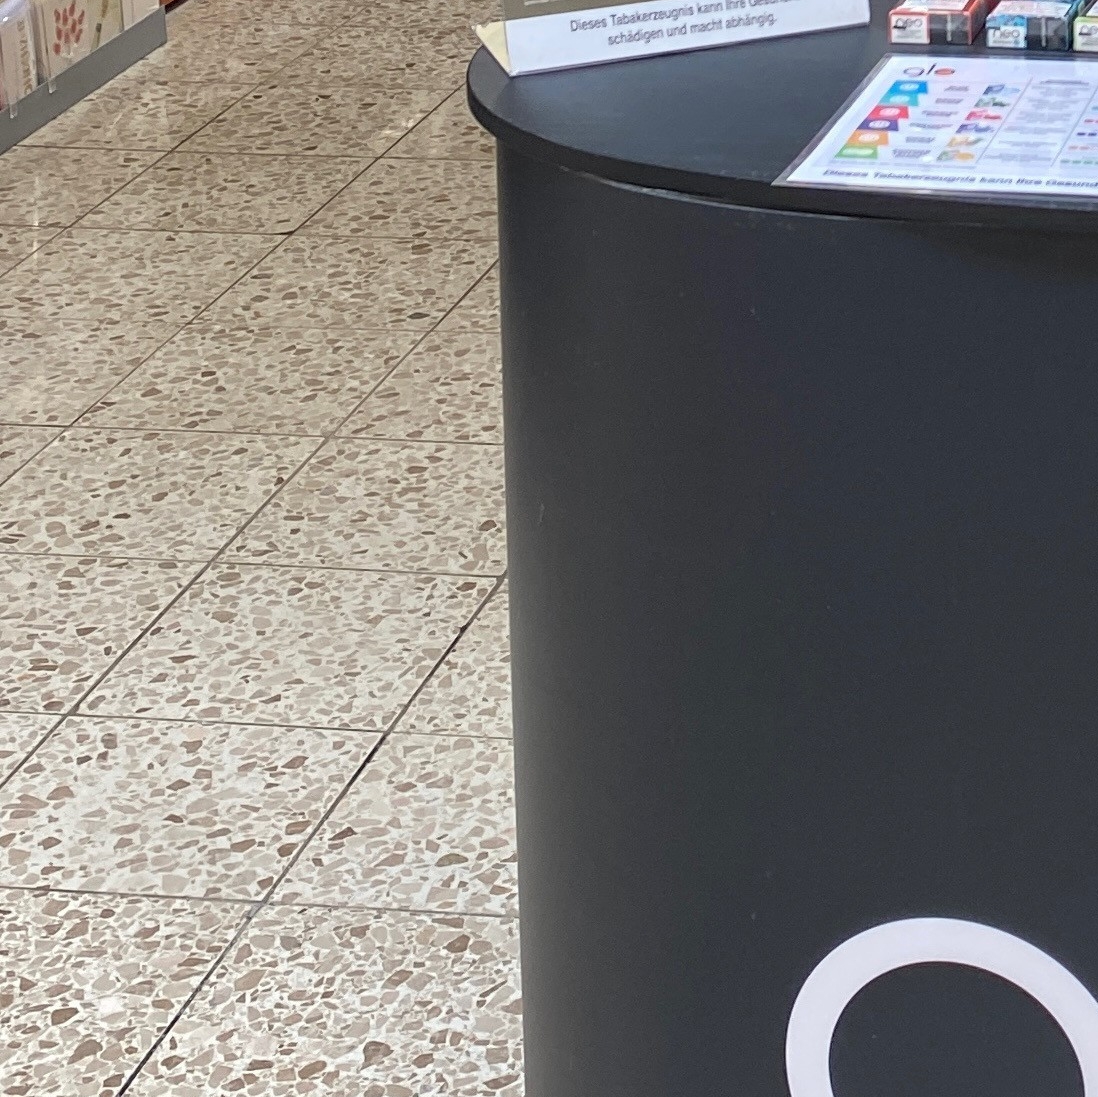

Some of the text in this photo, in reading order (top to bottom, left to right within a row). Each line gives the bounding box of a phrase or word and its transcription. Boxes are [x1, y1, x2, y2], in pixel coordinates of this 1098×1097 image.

[570, 15, 607, 33] Dieses
[610, 3, 694, 28] Tabakerzeugnis
[697, 0, 723, 15] kann
[607, 11, 777, 47] schädigen und macht abhängig.
